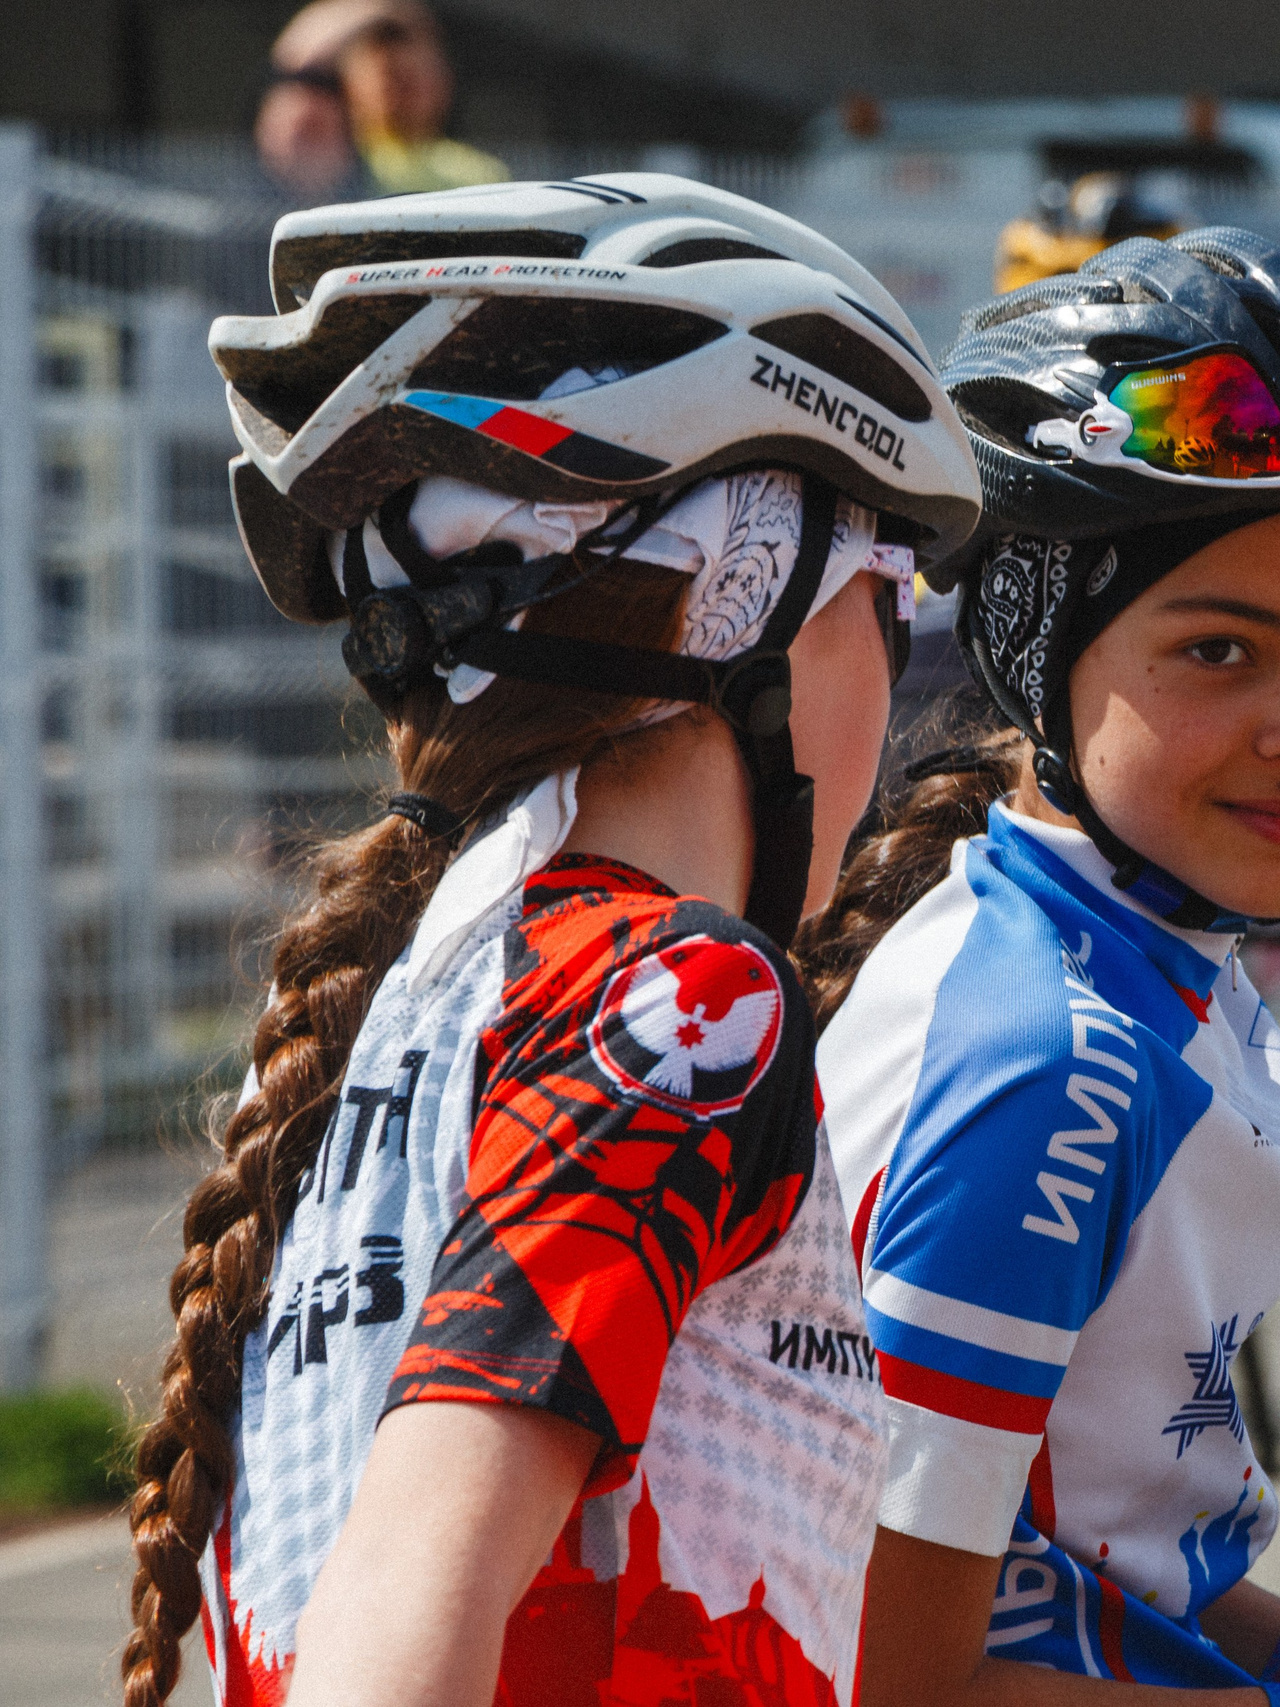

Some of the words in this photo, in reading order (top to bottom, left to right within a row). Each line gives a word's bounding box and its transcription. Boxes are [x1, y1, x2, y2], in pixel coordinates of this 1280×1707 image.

[346, 268, 419, 284] SUPER
[426, 265, 487, 278] HEAD
[493, 264, 626, 280] PROTECTION
[750, 354, 905, 472] ZHENCOOL
[768, 1319, 881, 1387] ИМПУ
